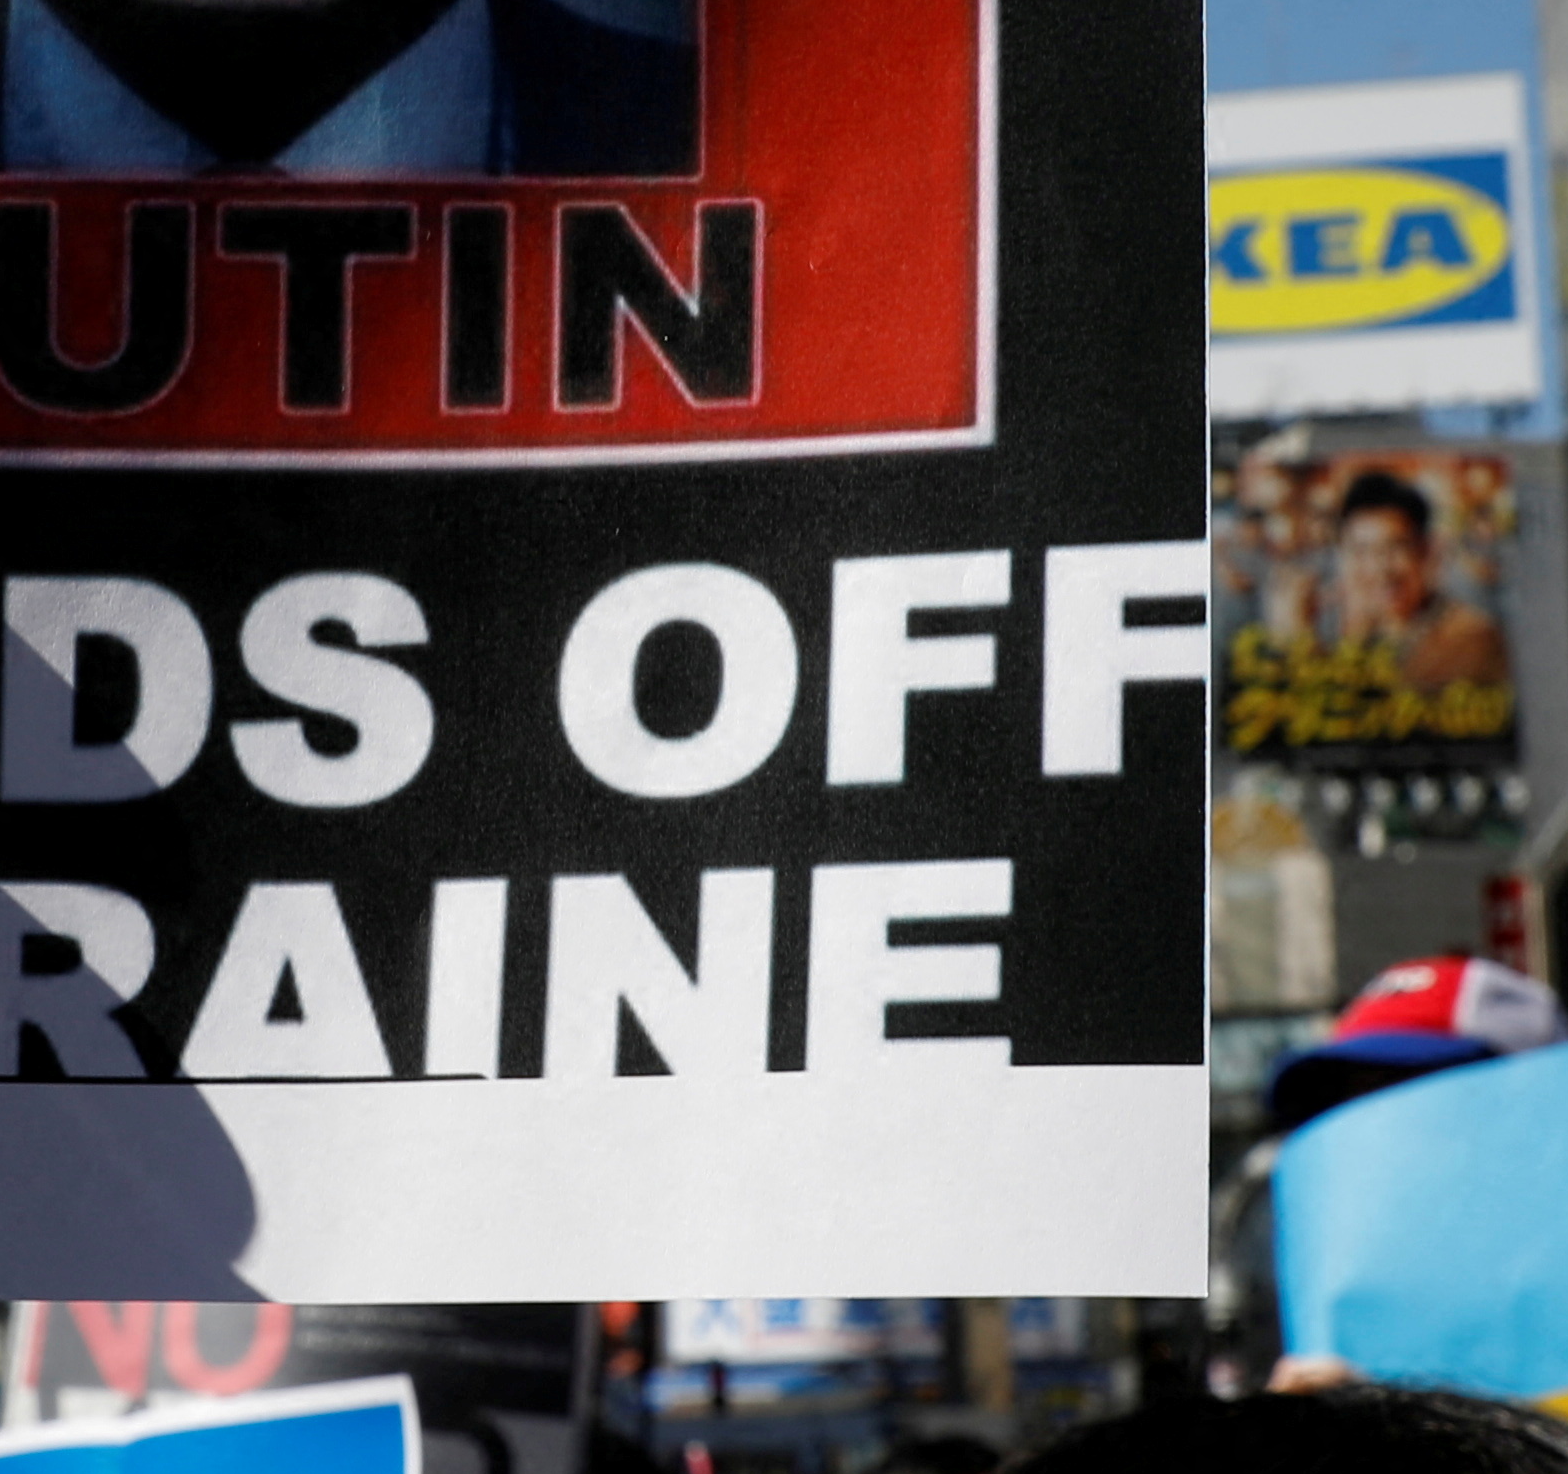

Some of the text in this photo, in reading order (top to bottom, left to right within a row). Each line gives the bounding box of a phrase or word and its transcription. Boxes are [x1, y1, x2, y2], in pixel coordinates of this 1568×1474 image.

[1207, 207, 1473, 281] KEA
[556, 539, 1206, 801] OFF
[24, 1301, 294, 1401] NO
